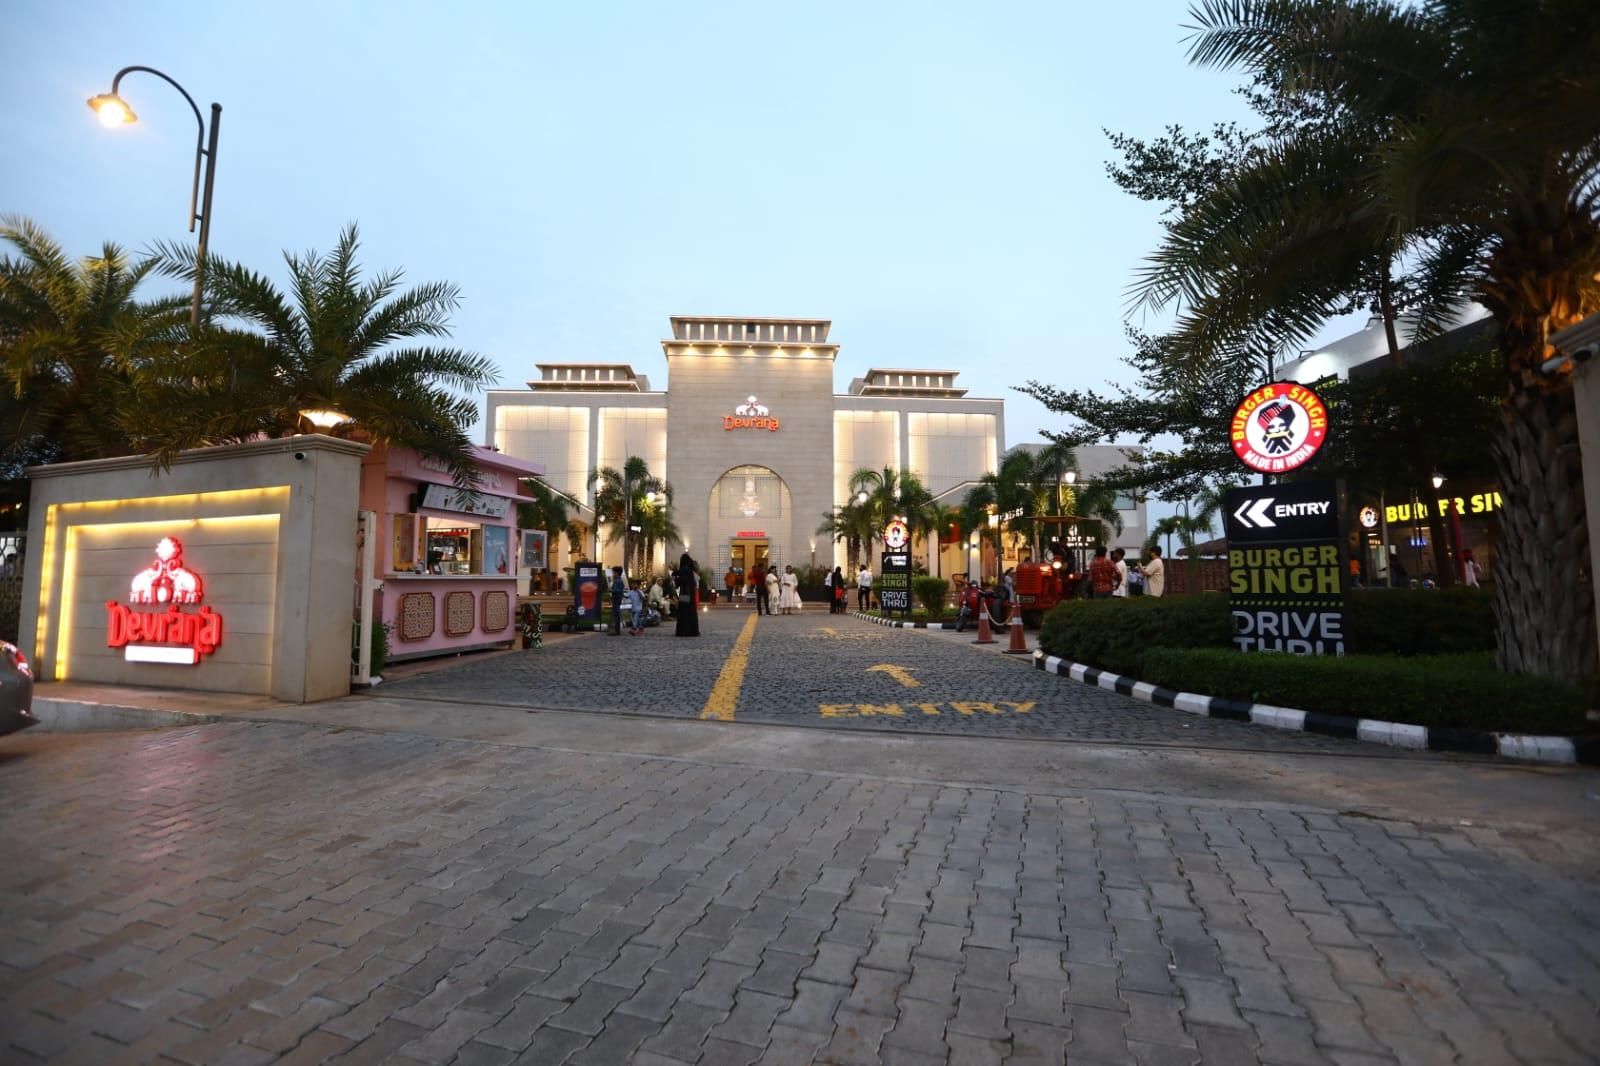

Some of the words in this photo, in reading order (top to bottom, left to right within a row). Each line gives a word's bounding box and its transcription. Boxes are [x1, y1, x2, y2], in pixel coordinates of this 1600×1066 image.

[723, 415, 779, 432] Devrana
[1232, 387, 1275, 440] BURGER
[1289, 387, 1325, 428] SINGH
[1243, 450, 1270, 469] MADE
[1272, 459, 1285, 470] IN
[1285, 443, 1316, 467] INDIA
[1275, 501, 1330, 517] ENTRY
[1385, 498, 1466, 523] BURER
[1229, 545, 1339, 568] BURGER
[882, 579, 907, 587] SINGH
[1230, 567, 1341, 594] SINGH
[881, 591, 907, 599] DRIVE
[882, 599, 907, 607] THRU
[106, 601, 222, 654] Devrana
[1232, 610, 1344, 639] DRIVE
[819, 702, 1037, 717] ENTRY
